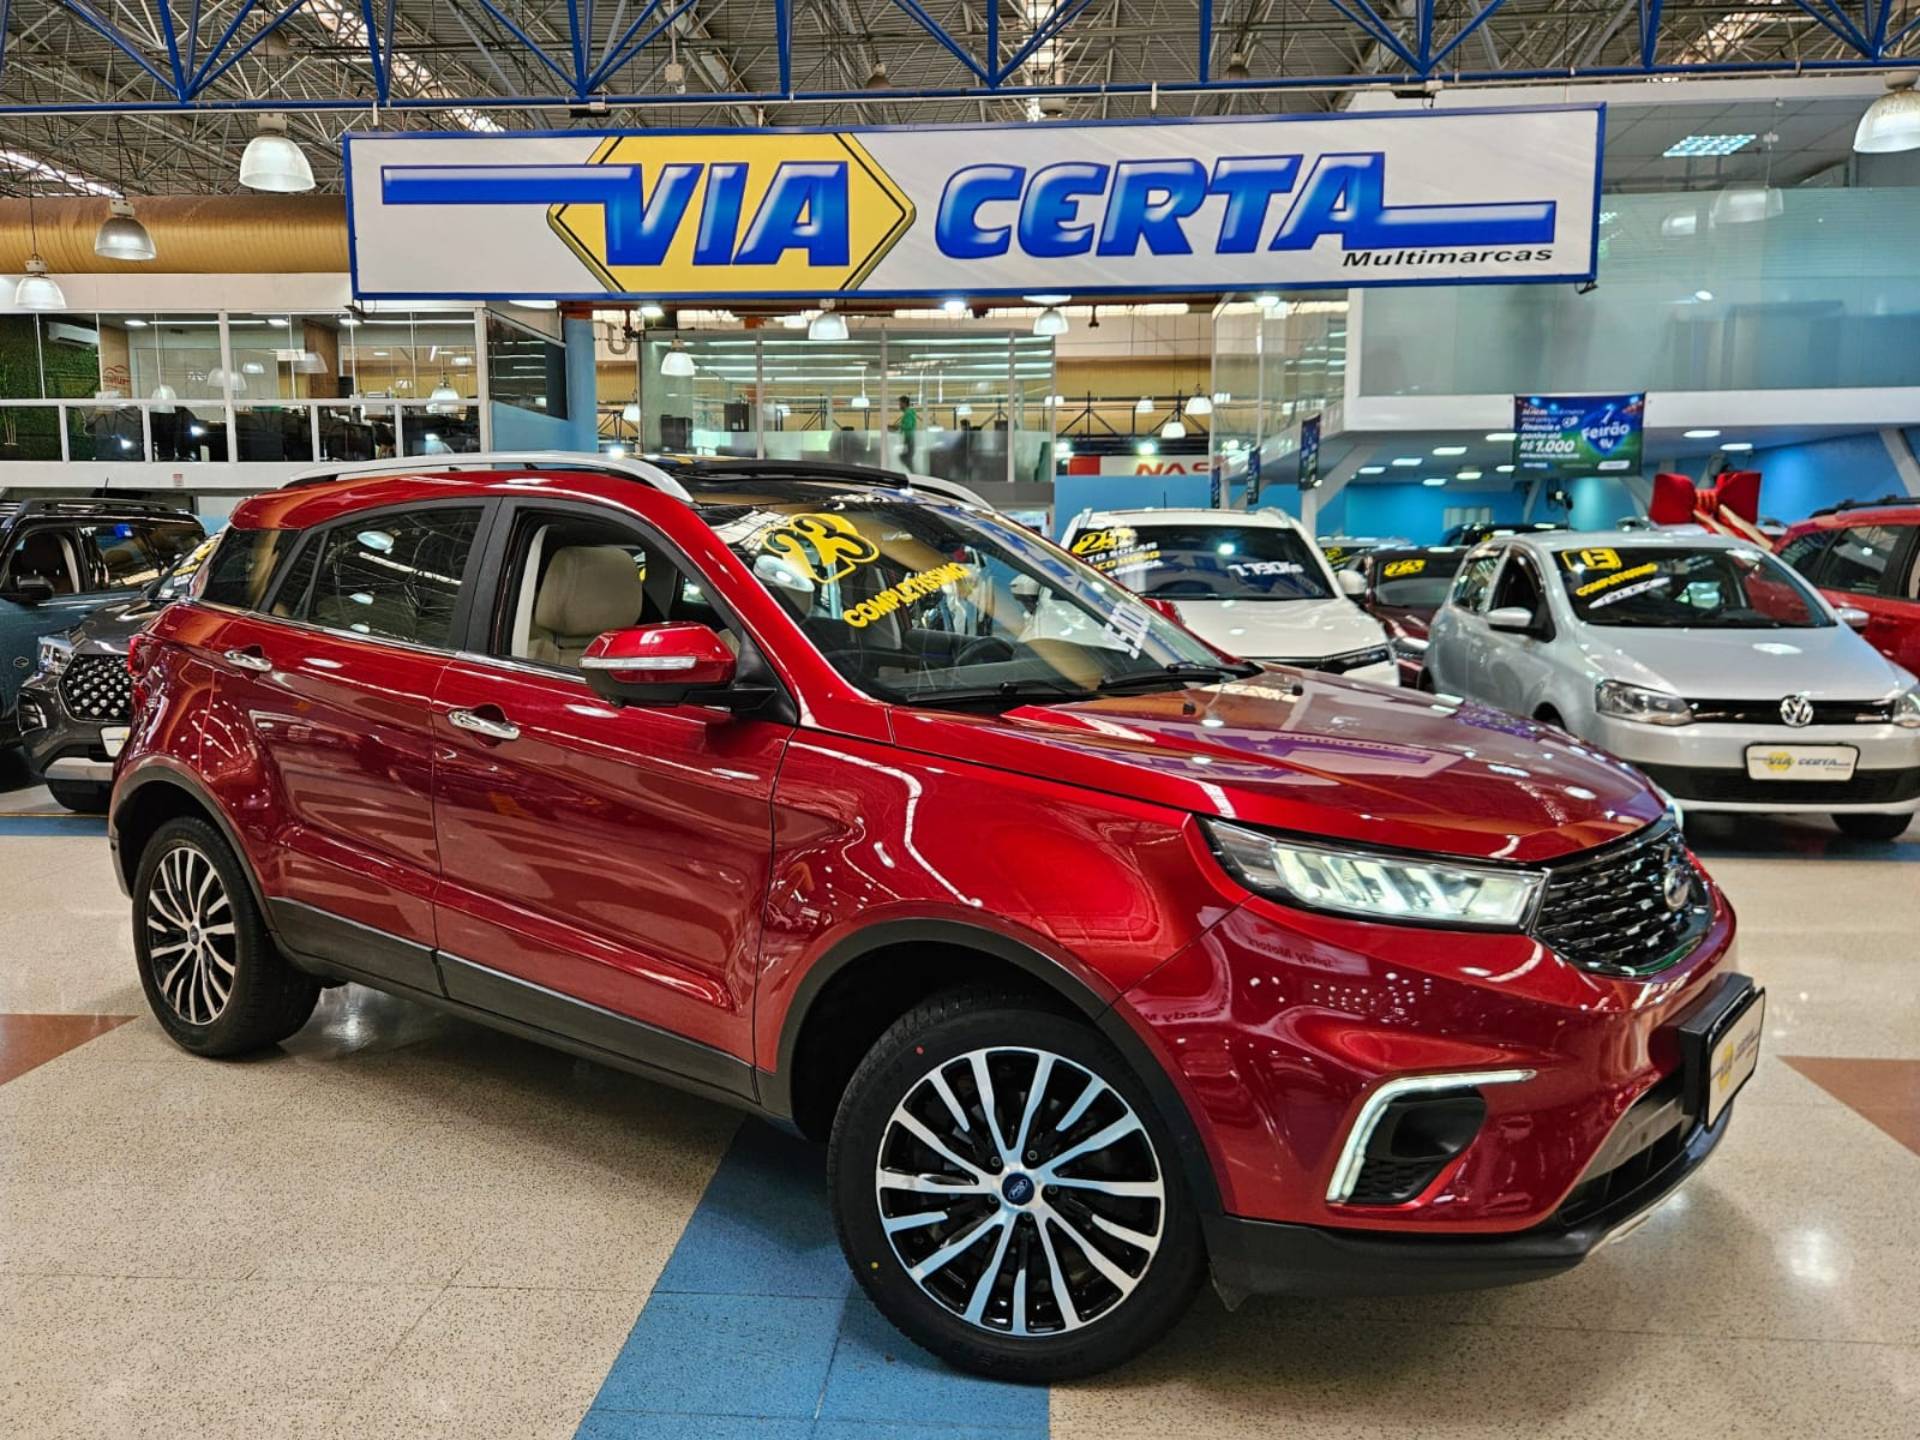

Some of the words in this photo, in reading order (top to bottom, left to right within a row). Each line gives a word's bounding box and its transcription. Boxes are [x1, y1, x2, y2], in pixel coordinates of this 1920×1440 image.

[605, 161, 850, 266] VIA
[935, 152, 1385, 259] CERTA
[1342, 249, 1553, 267] Multimarcas
[1581, 422, 1630, 440] Feirão
[1535, 440, 1575, 453] 1.000
[761, 513, 880, 583] 23
